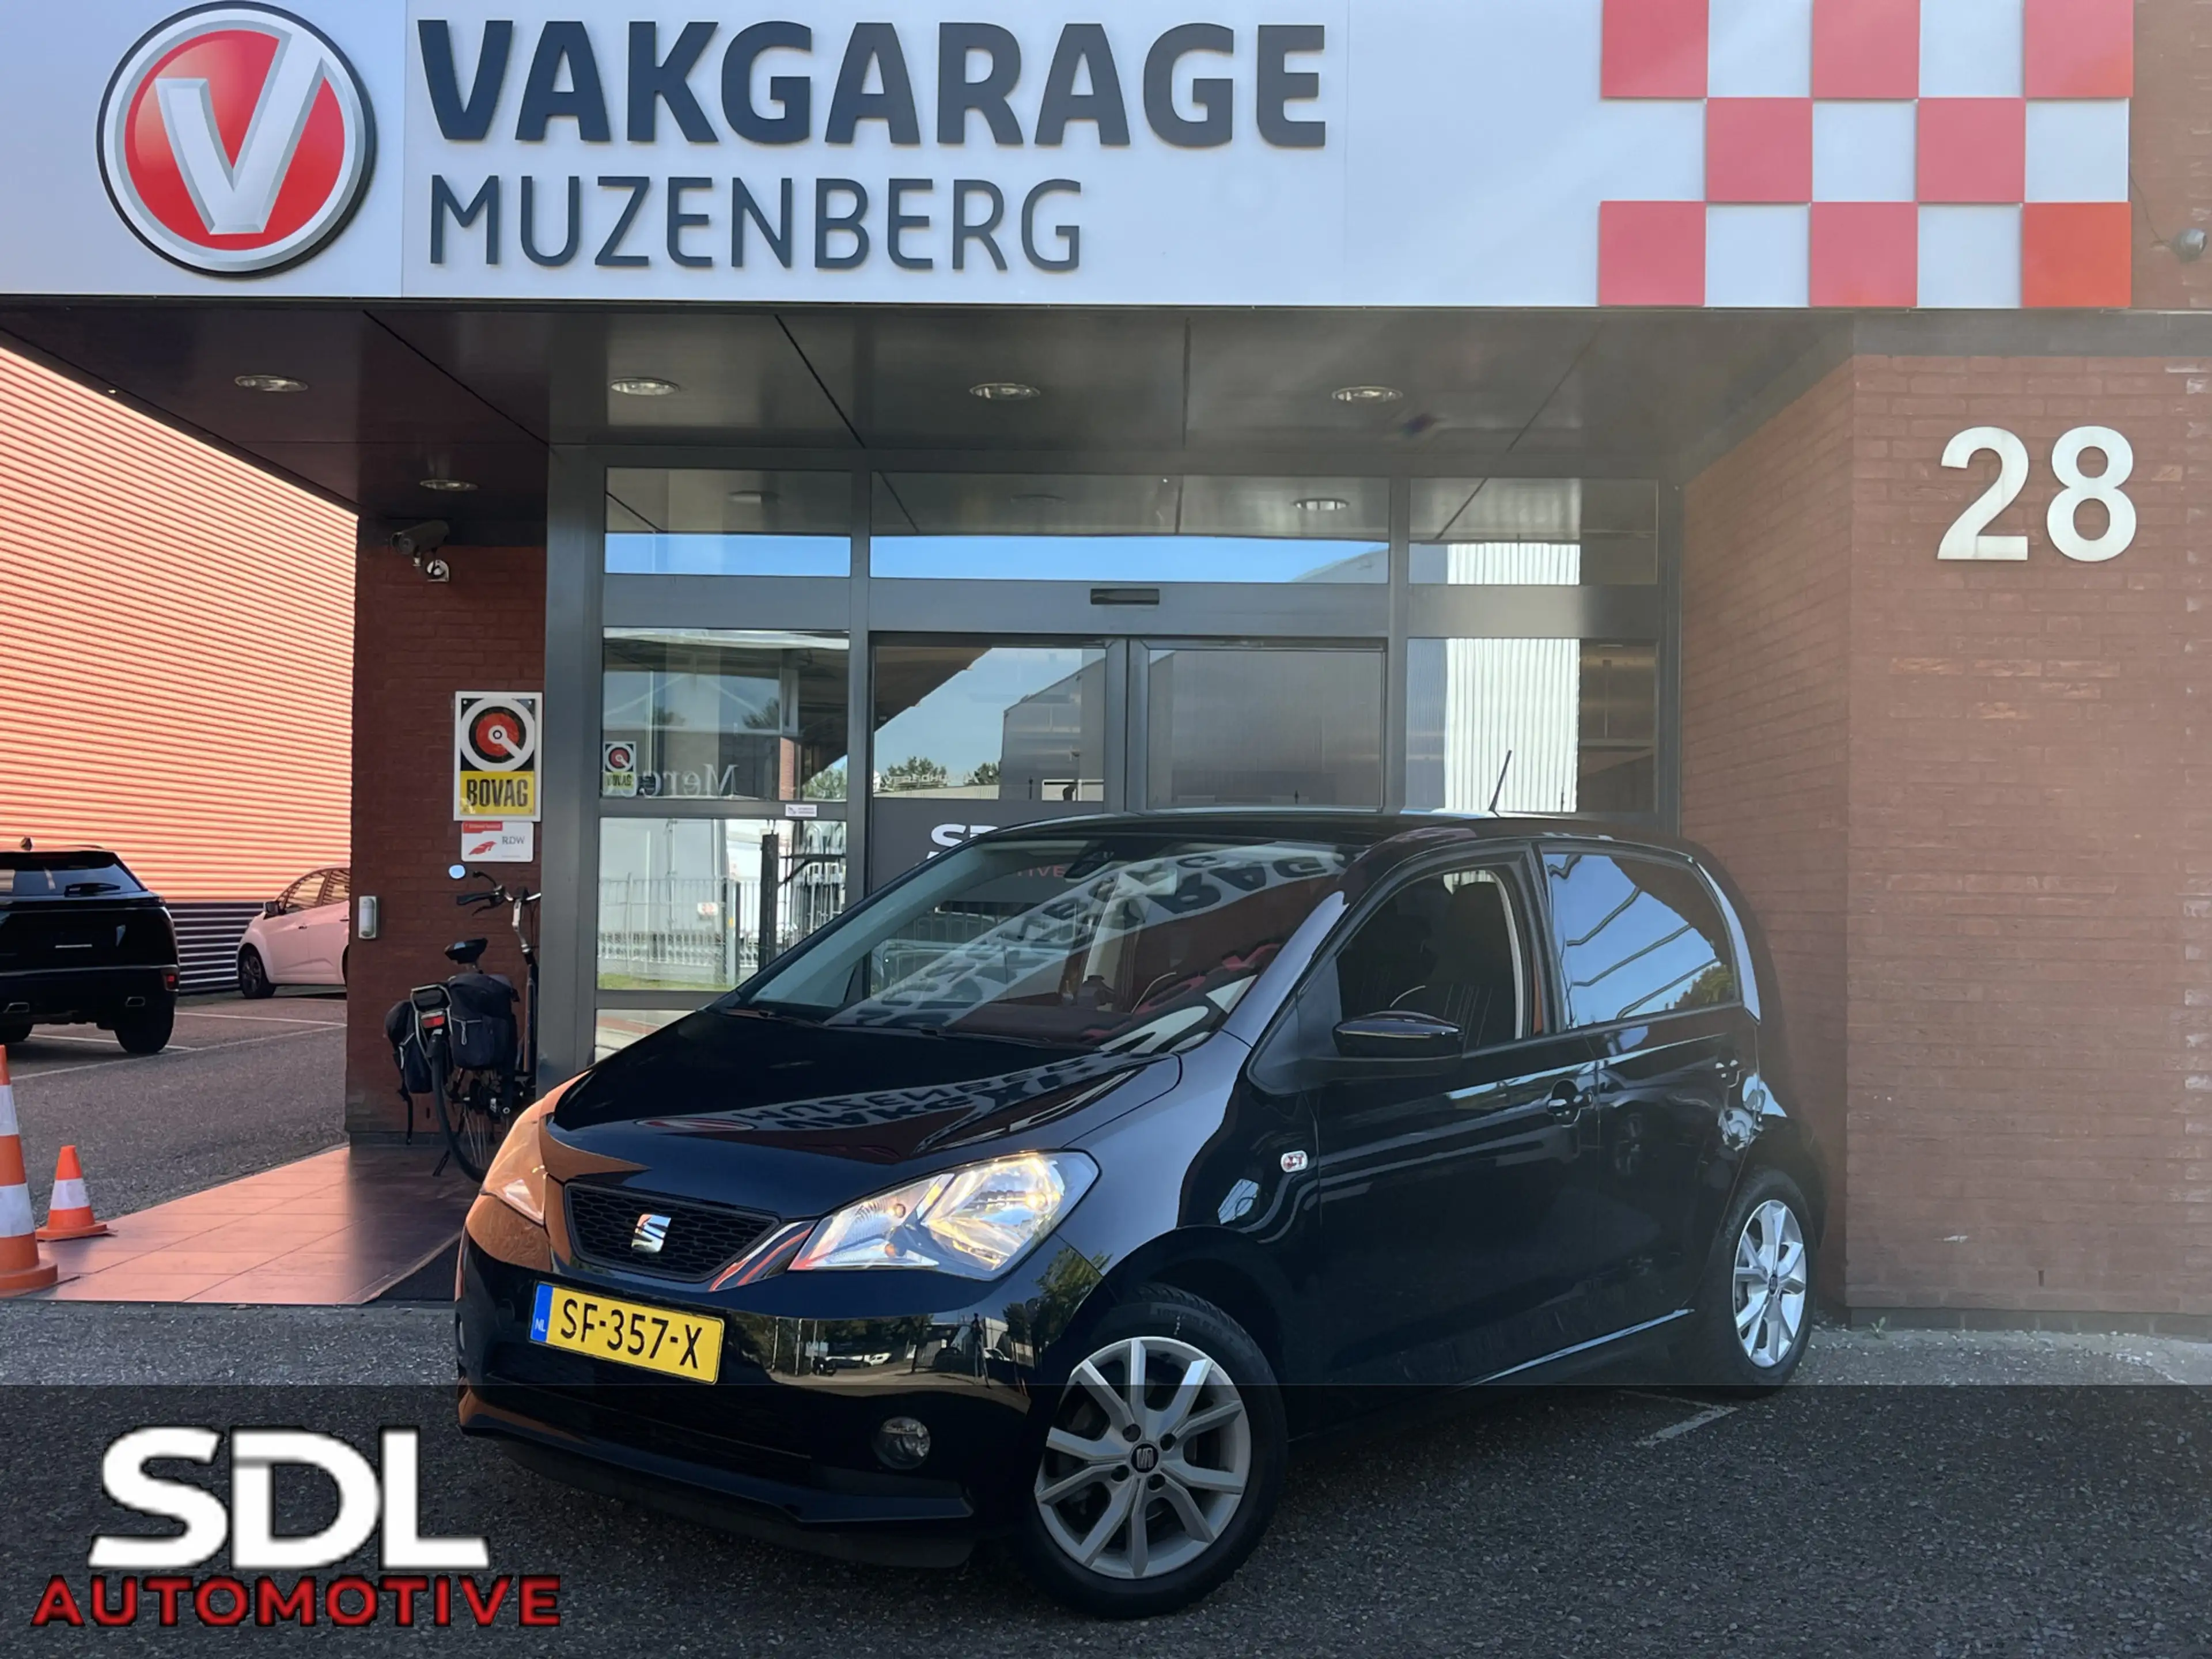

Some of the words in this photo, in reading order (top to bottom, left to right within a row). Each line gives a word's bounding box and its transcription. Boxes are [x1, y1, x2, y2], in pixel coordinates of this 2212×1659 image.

[418, 20, 1326, 147] VAKGARAGE
[430, 175, 1081, 271] MUZENBERG
[1937, 426, 2137, 562] 28
[466, 779, 528, 807] BOVAG
[502, 836, 525, 844] RDW
[534, 1318, 546, 1332] NL
[560, 1298, 702, 1369] SF-357-X
